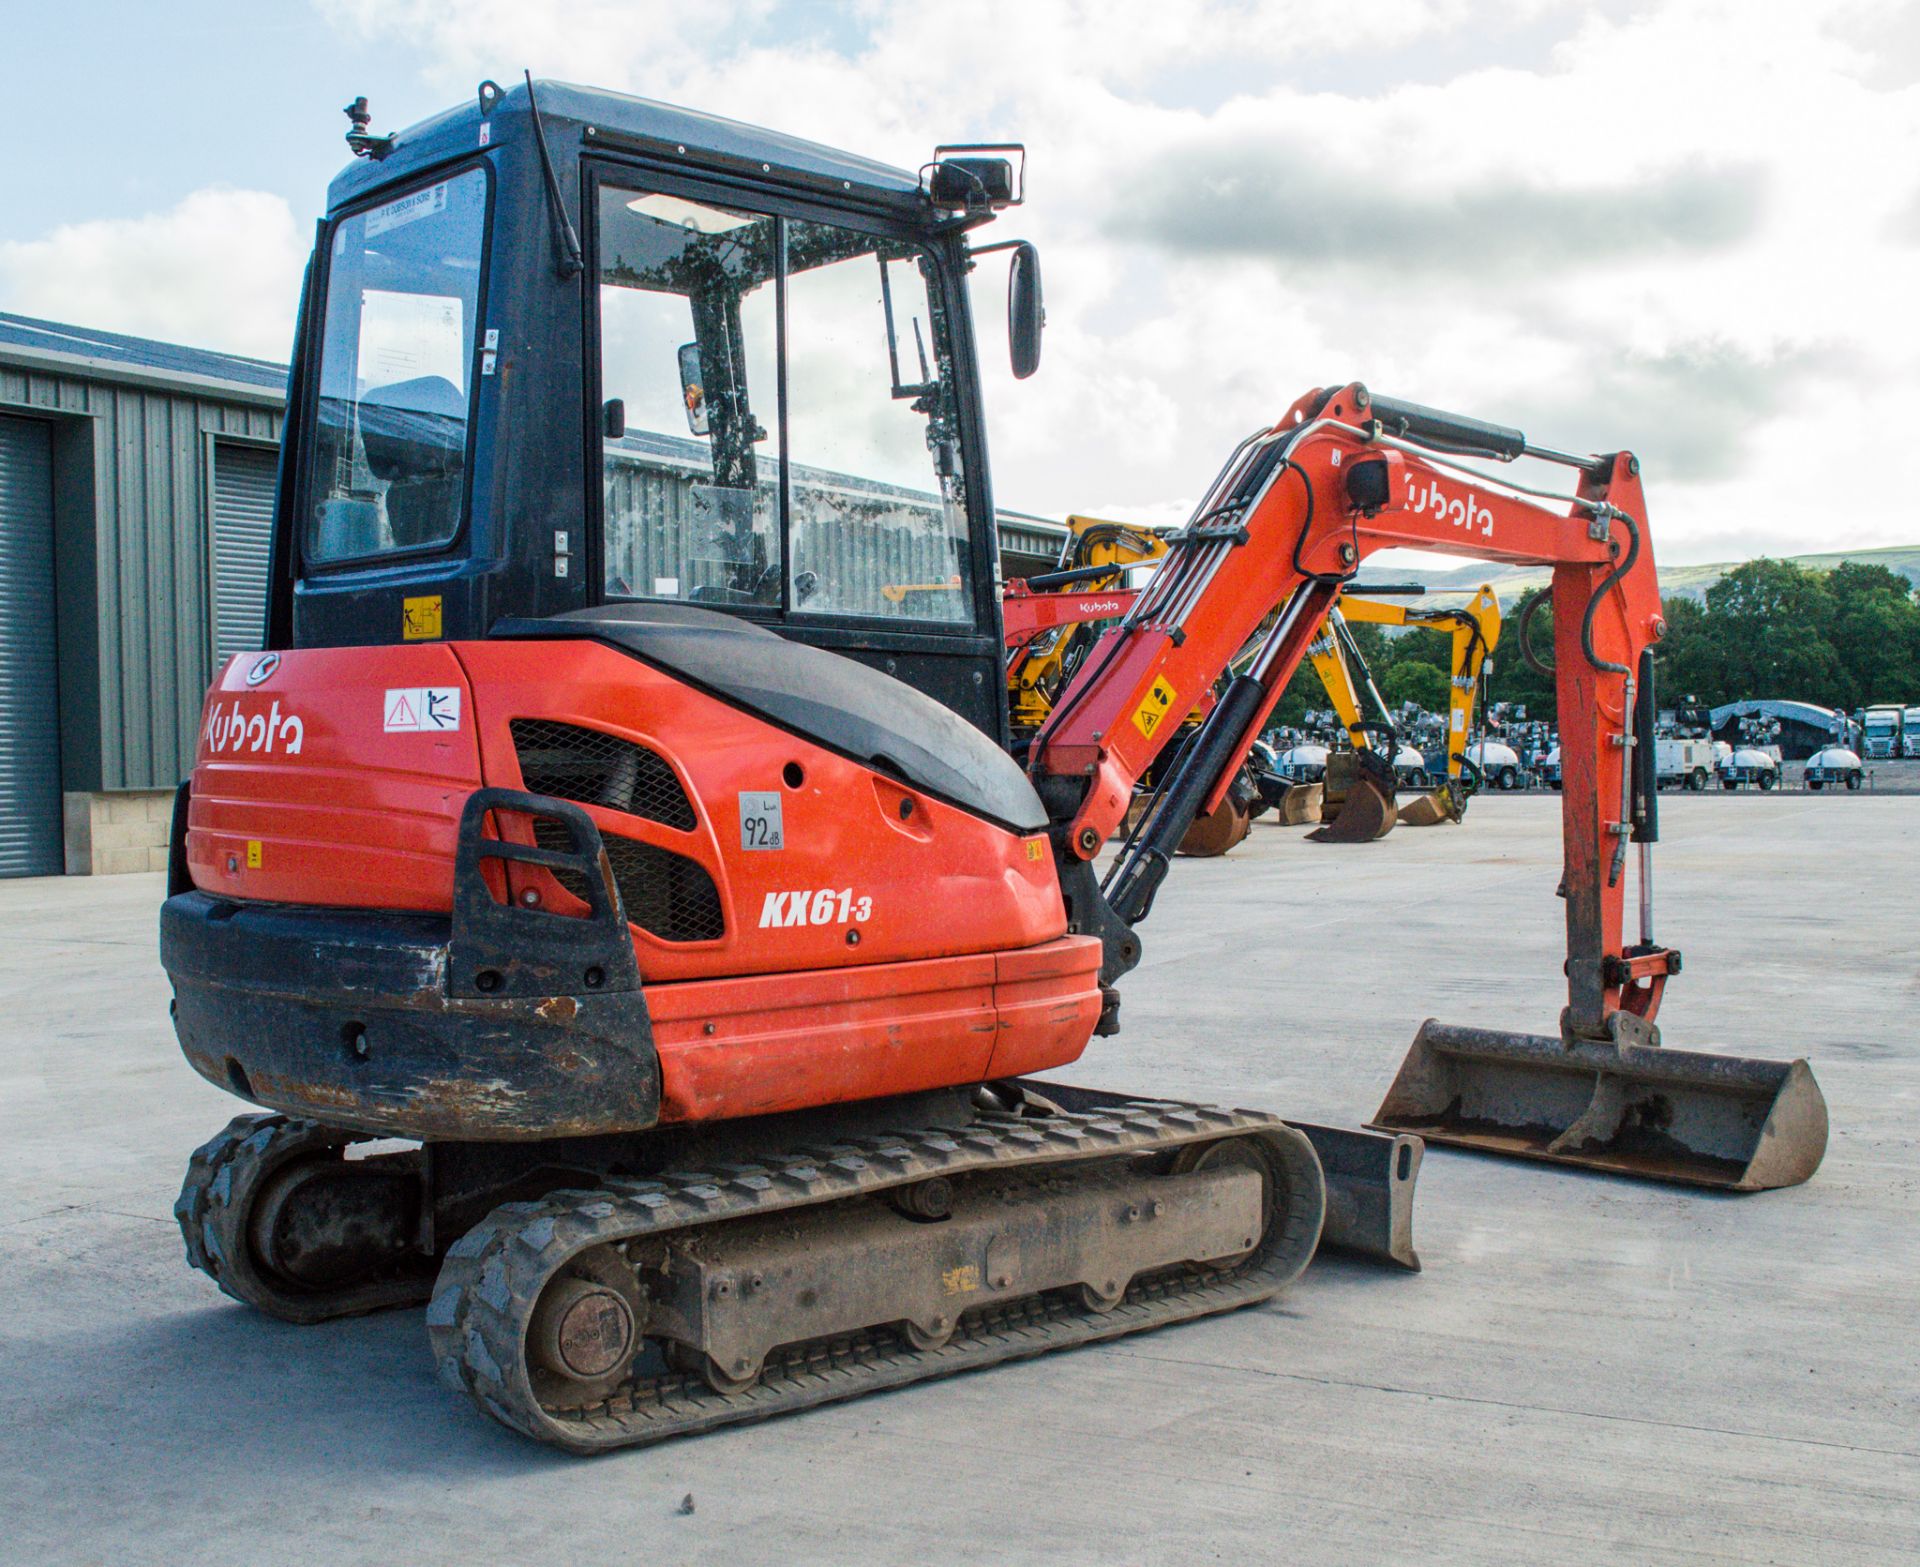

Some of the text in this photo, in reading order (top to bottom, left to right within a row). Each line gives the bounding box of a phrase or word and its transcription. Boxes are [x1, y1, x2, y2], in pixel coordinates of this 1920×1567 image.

[1080, 600, 1119, 613] Kubota
[206, 700, 304, 754] Kubota
[744, 817, 780, 846] 92 dB
[758, 887, 873, 929] KX61-3
